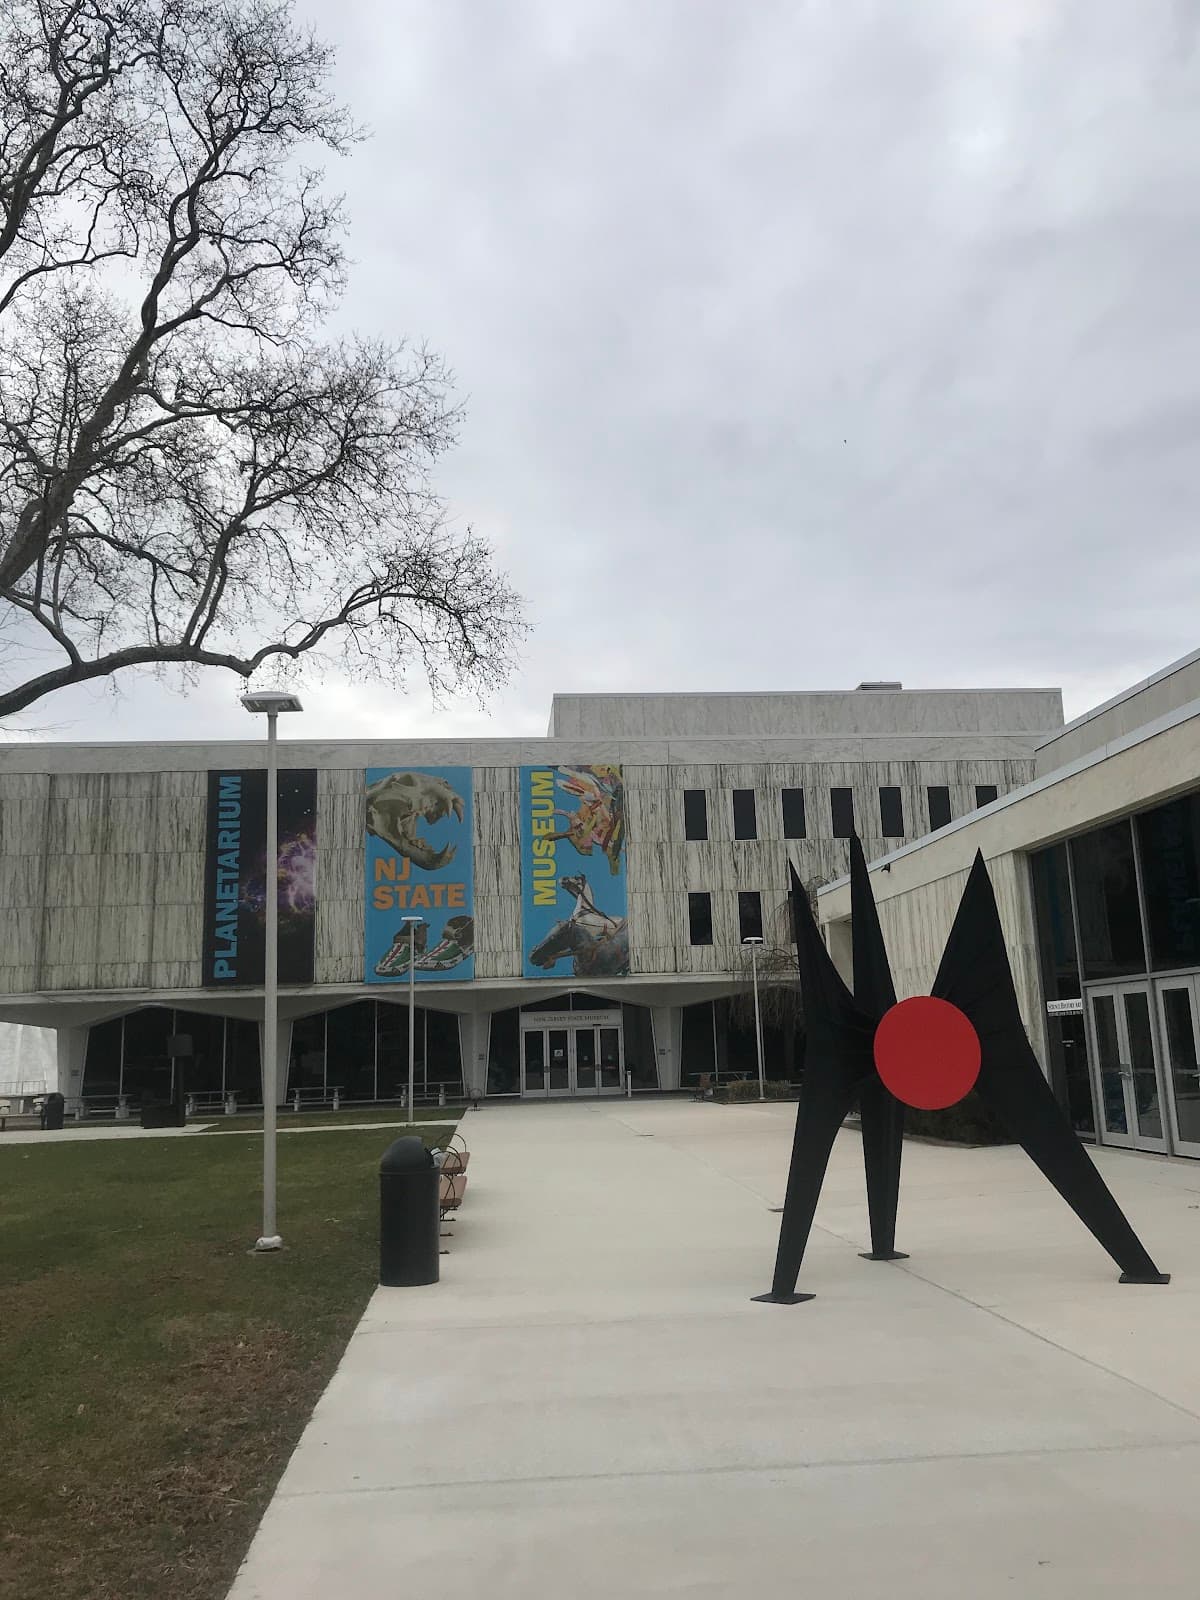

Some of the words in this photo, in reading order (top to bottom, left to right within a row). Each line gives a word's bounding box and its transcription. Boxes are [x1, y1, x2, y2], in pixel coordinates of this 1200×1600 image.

[213, 776, 242, 979] PLANETARIUM
[374, 857, 411, 881] NJ
[530, 771, 558, 906] MUSEUM
[373, 883, 465, 910] STATE
